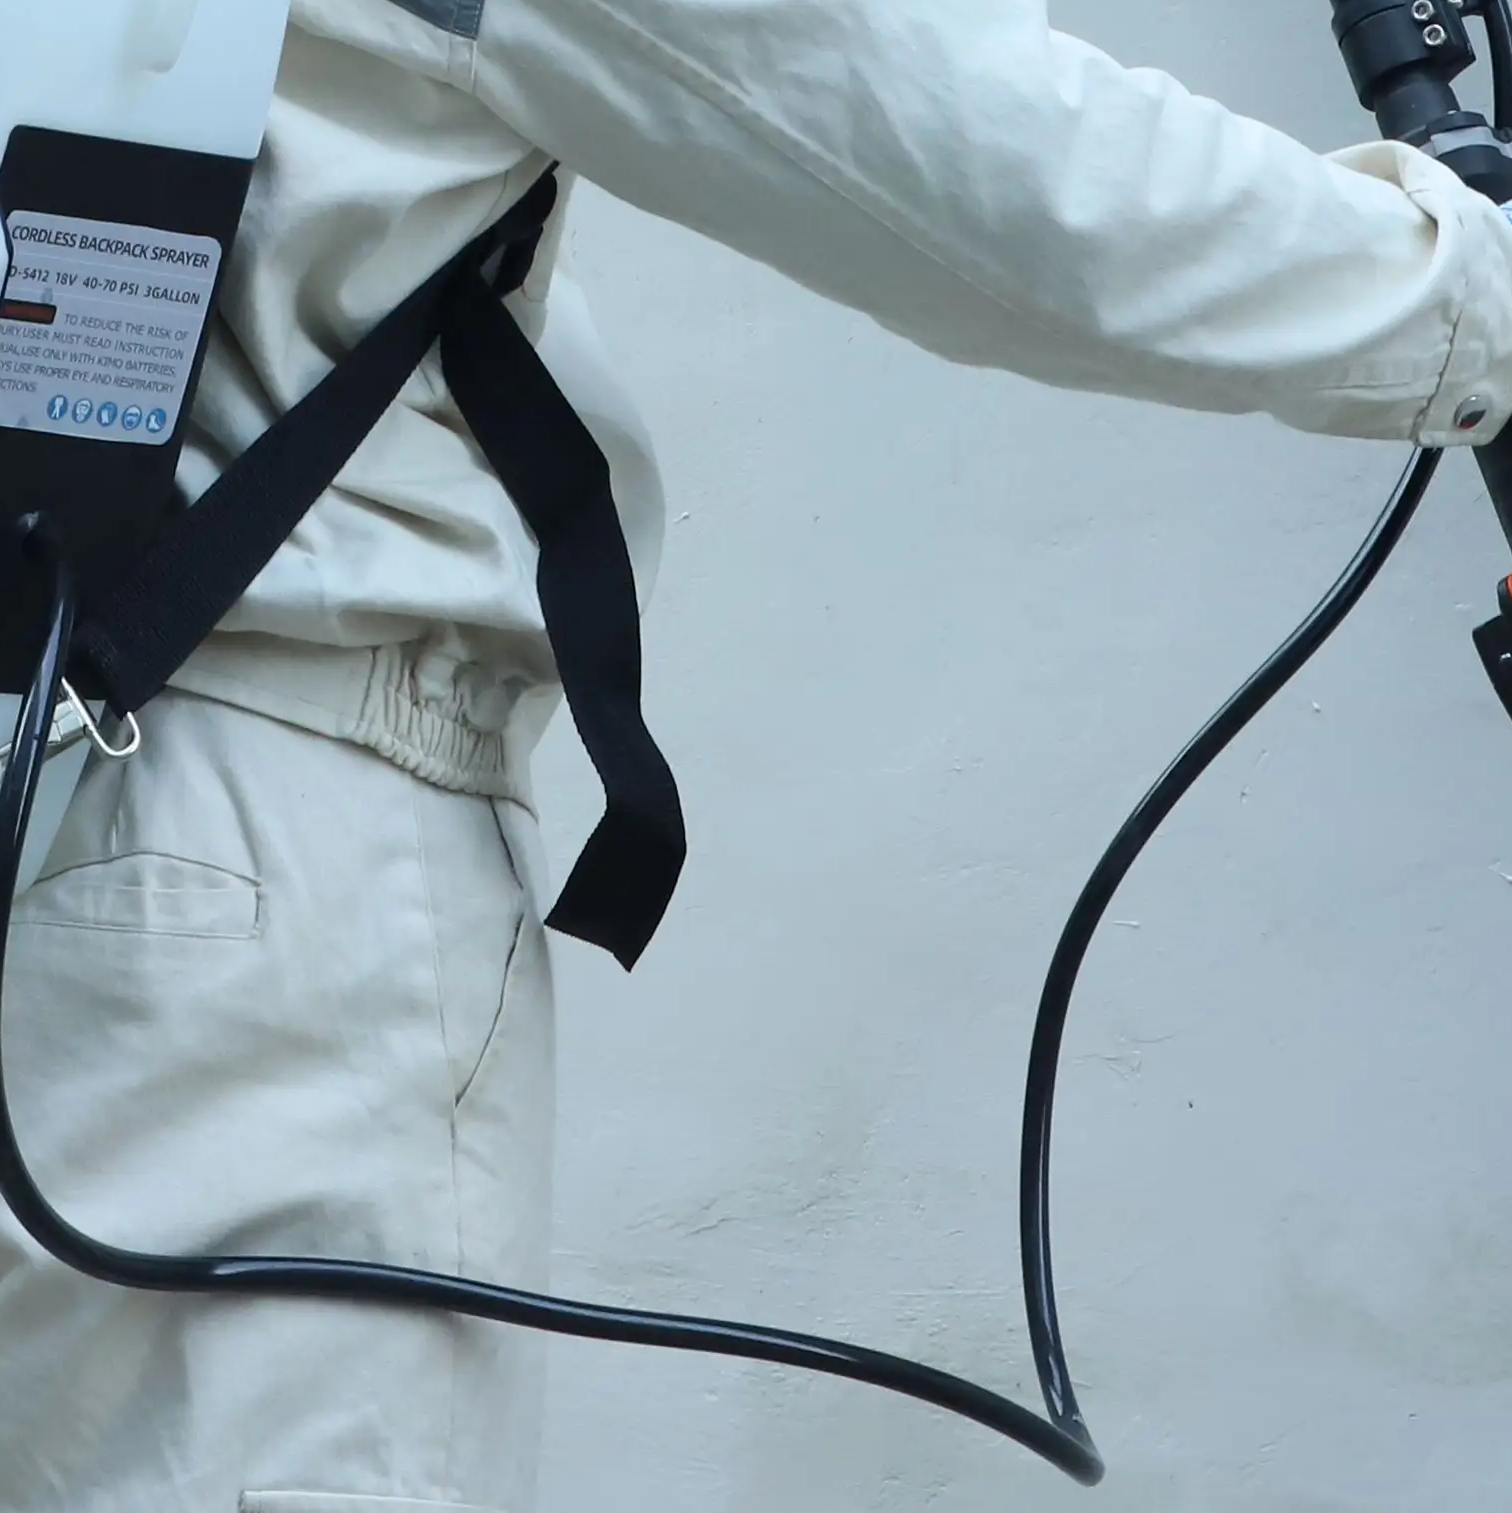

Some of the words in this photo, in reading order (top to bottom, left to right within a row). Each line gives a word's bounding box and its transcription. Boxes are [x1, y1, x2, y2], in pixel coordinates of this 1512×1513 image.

[12, 225, 77, 248] CORDLESS
[78, 235, 150, 260] BACKPACK
[150, 246, 210, 268] SPRAYER
[55, 272, 78, 286] 18V
[82, 277, 118, 292] 40-70
[118, 281, 139, 296] PSI
[143, 285, 201, 304] 3GALLON
[65, 313, 78, 326] TO
[80, 316, 122, 332] REDUCE
[125, 322, 145, 335] THE
[147, 326, 172, 340] RISK
[174, 329, 189, 341] OF
[52, 331, 82, 345] MUST
[84, 335, 111, 348] READ
[114, 340, 184, 360] INSTRUCTION
[70, 352, 96, 365] WITH
[34, 364, 71, 380] PROPER
